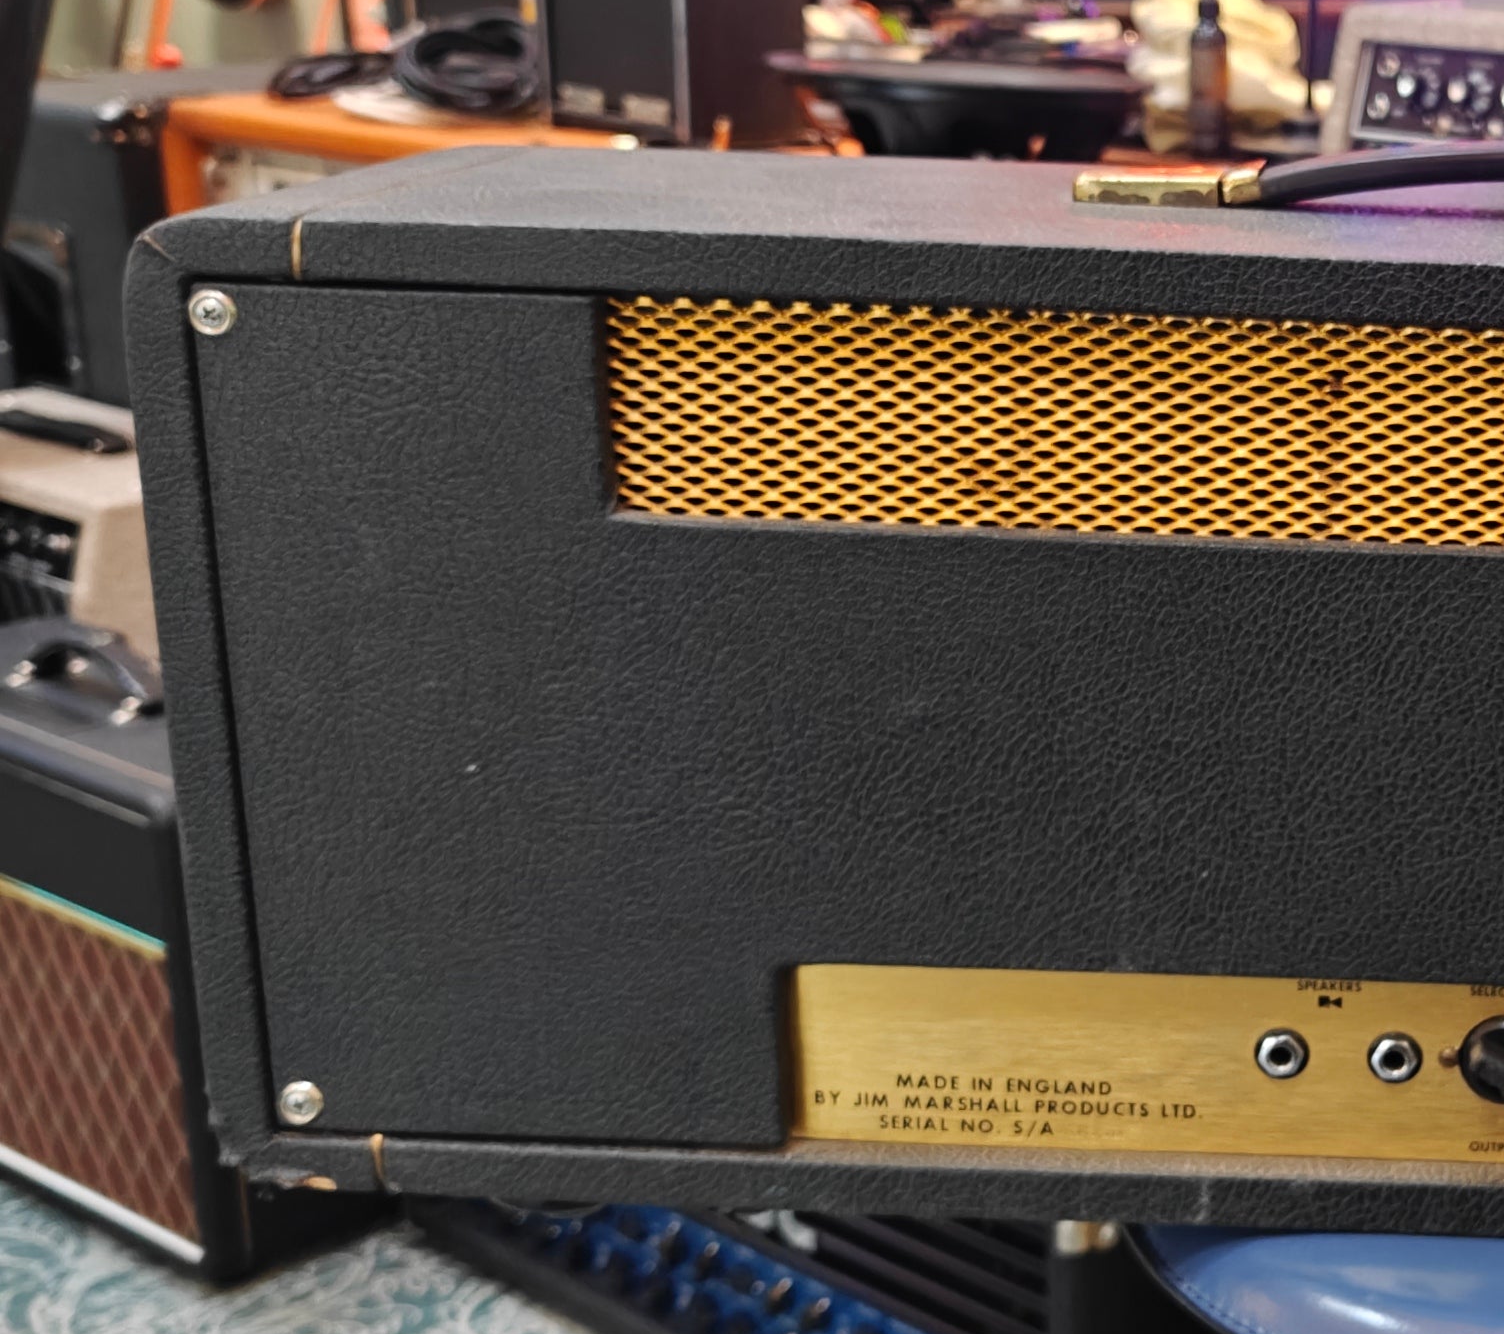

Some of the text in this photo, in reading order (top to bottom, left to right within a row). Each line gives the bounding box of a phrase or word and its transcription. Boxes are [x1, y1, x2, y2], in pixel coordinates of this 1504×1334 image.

[1297, 979, 1362, 992] SPEAKERS
[896, 1074, 1112, 1096] MADE IN ENGLAND
[814, 1090, 841, 1105] BY
[854, 1092, 889, 1108] JIM
[904, 1095, 1022, 1113] MARSHALL
[1034, 1100, 1150, 1118] PRODUCTS
[879, 1114, 949, 1132] SERIAL
[1013, 1119, 1054, 1137] S/A
